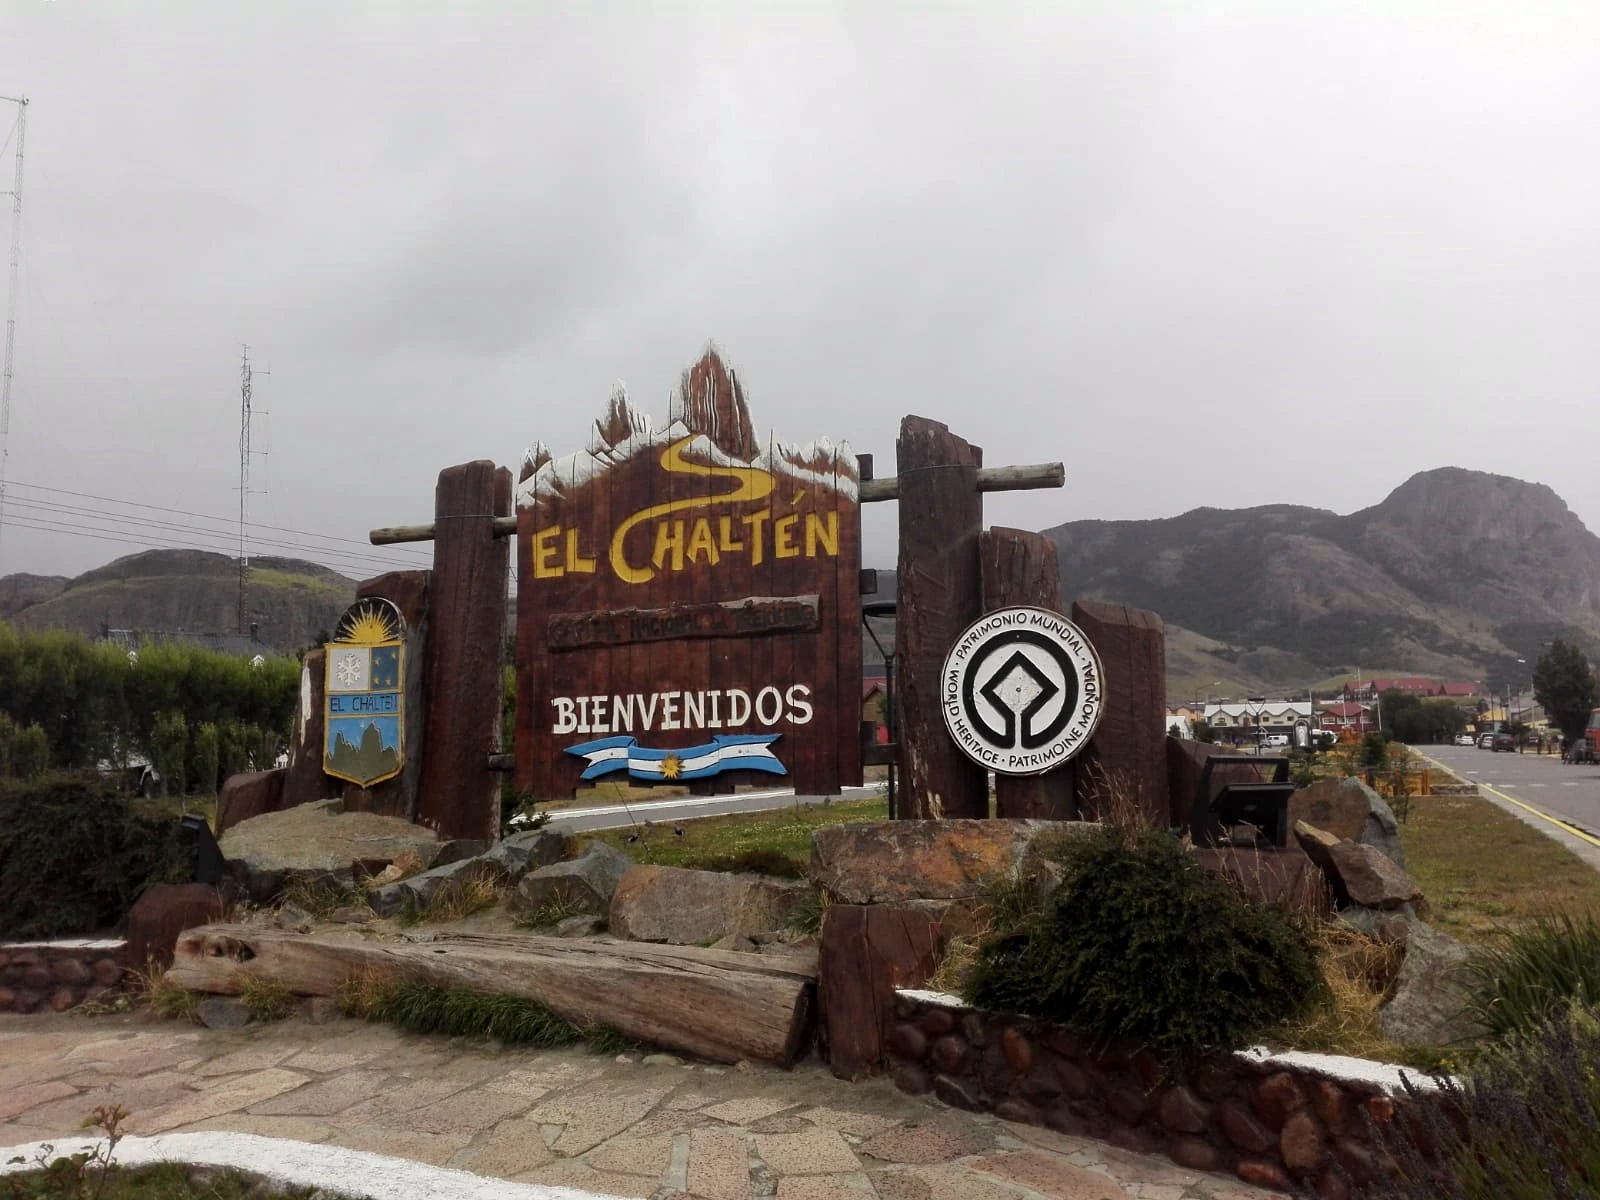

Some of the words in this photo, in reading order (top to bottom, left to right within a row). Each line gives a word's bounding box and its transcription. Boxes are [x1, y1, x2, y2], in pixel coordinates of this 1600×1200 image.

[531, 525, 597, 579] EL
[609, 488, 839, 583] CHALTÉN
[956, 612, 1028, 660] PATRIMONIO
[1030, 614, 1084, 657] MUNDIAL
[330, 697, 345, 713] EL
[551, 684, 815, 735] BIENVENIDOS
[947, 669, 960, 716] WORLD
[1008, 727, 1084, 768] PATRIMOINE
[1078, 660, 1097, 728] MONDIAL
[953, 718, 1000, 764] HERITAGE
